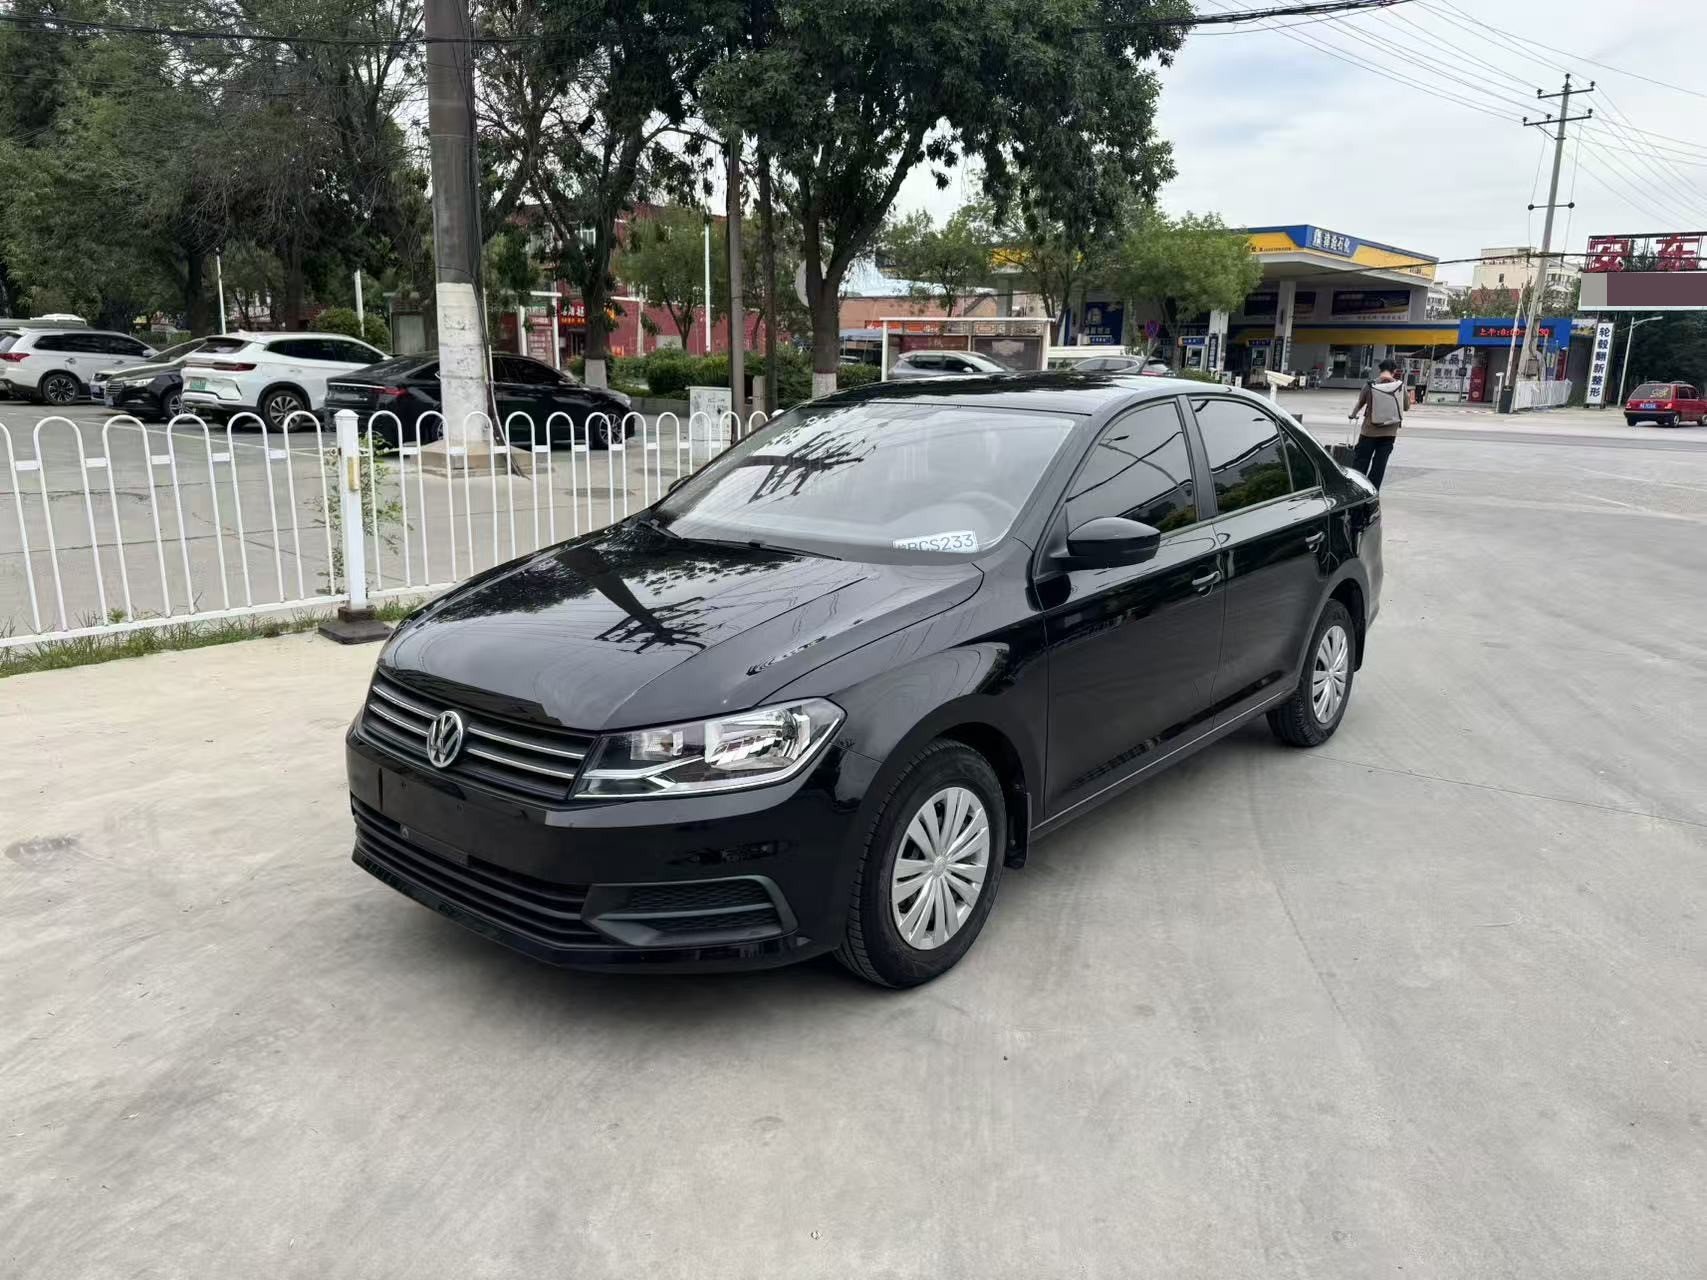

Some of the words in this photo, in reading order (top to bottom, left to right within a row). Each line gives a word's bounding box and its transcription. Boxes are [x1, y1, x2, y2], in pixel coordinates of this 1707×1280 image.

[1589, 327, 1611, 398] 轮毂翻新整形
